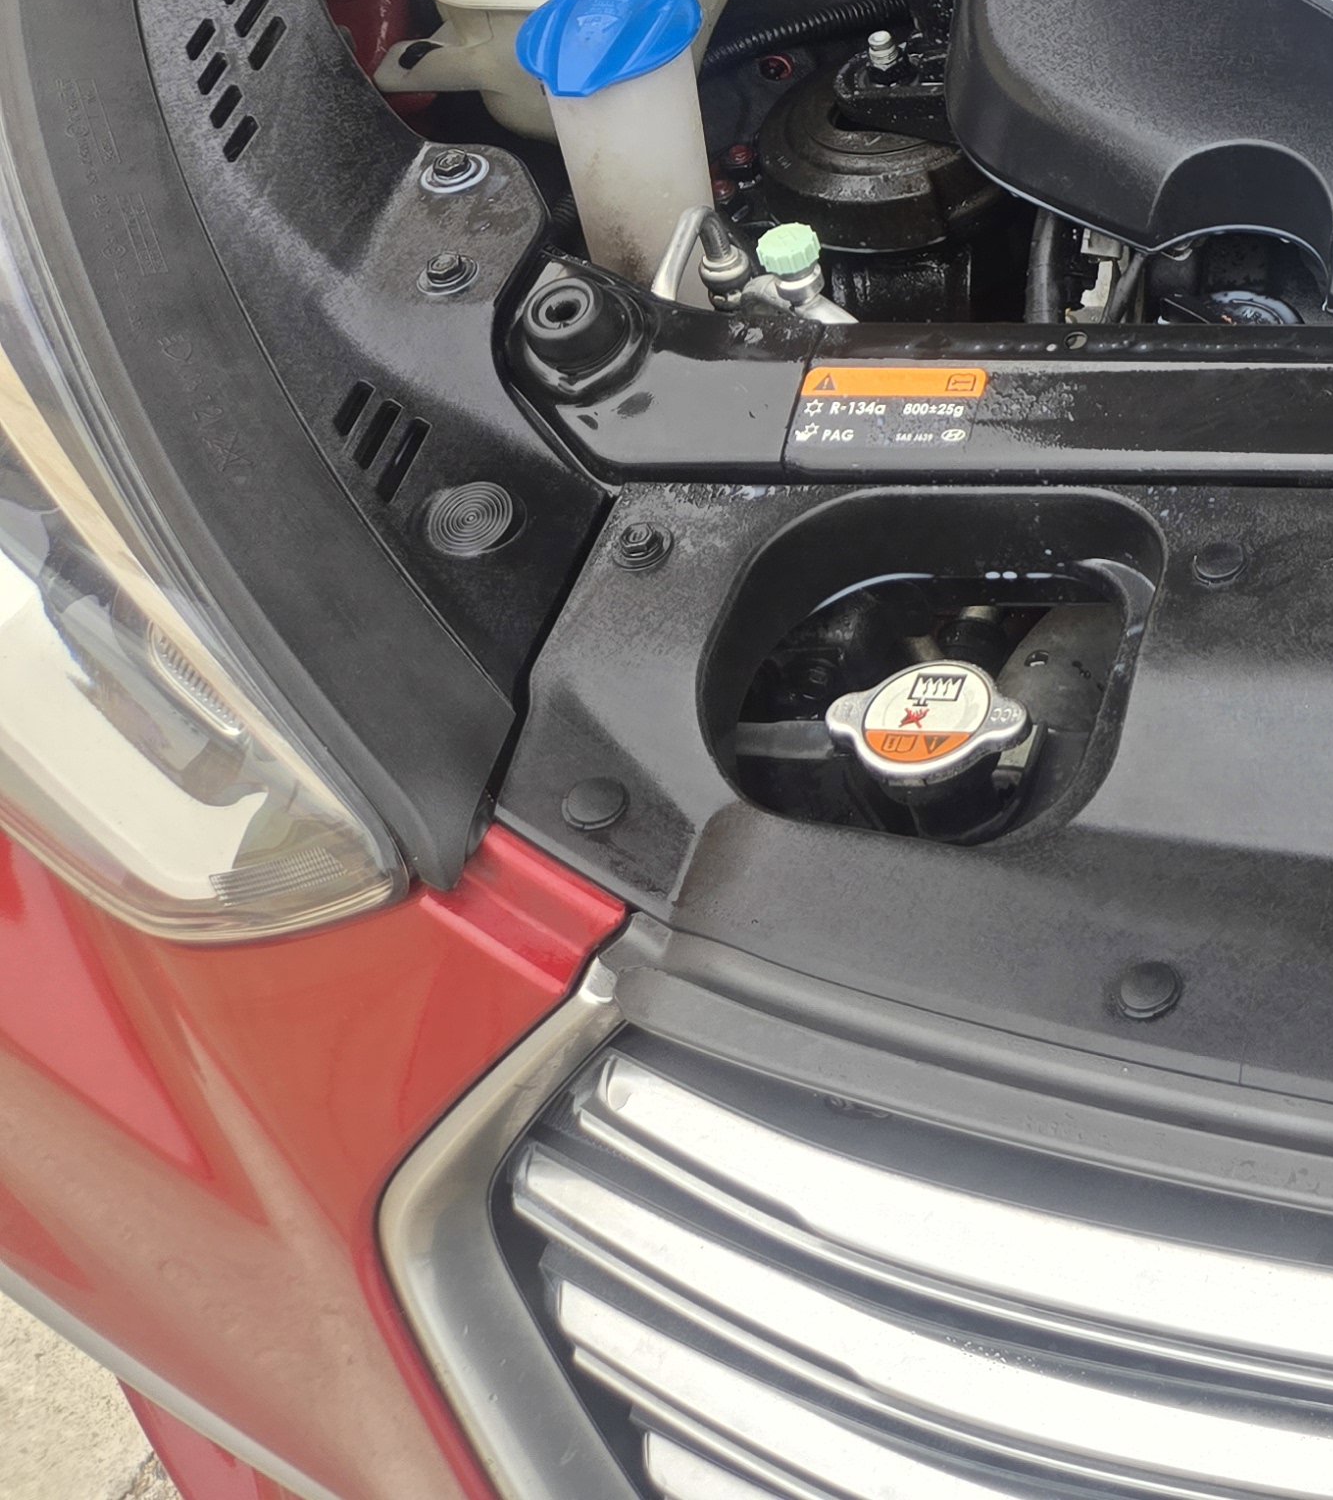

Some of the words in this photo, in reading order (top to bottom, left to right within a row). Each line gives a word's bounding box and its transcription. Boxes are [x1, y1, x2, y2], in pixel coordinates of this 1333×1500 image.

[829, 401, 887, 415] R-134a
[902, 403, 965, 417] 800±25g
[821, 429, 854, 442] PAG
